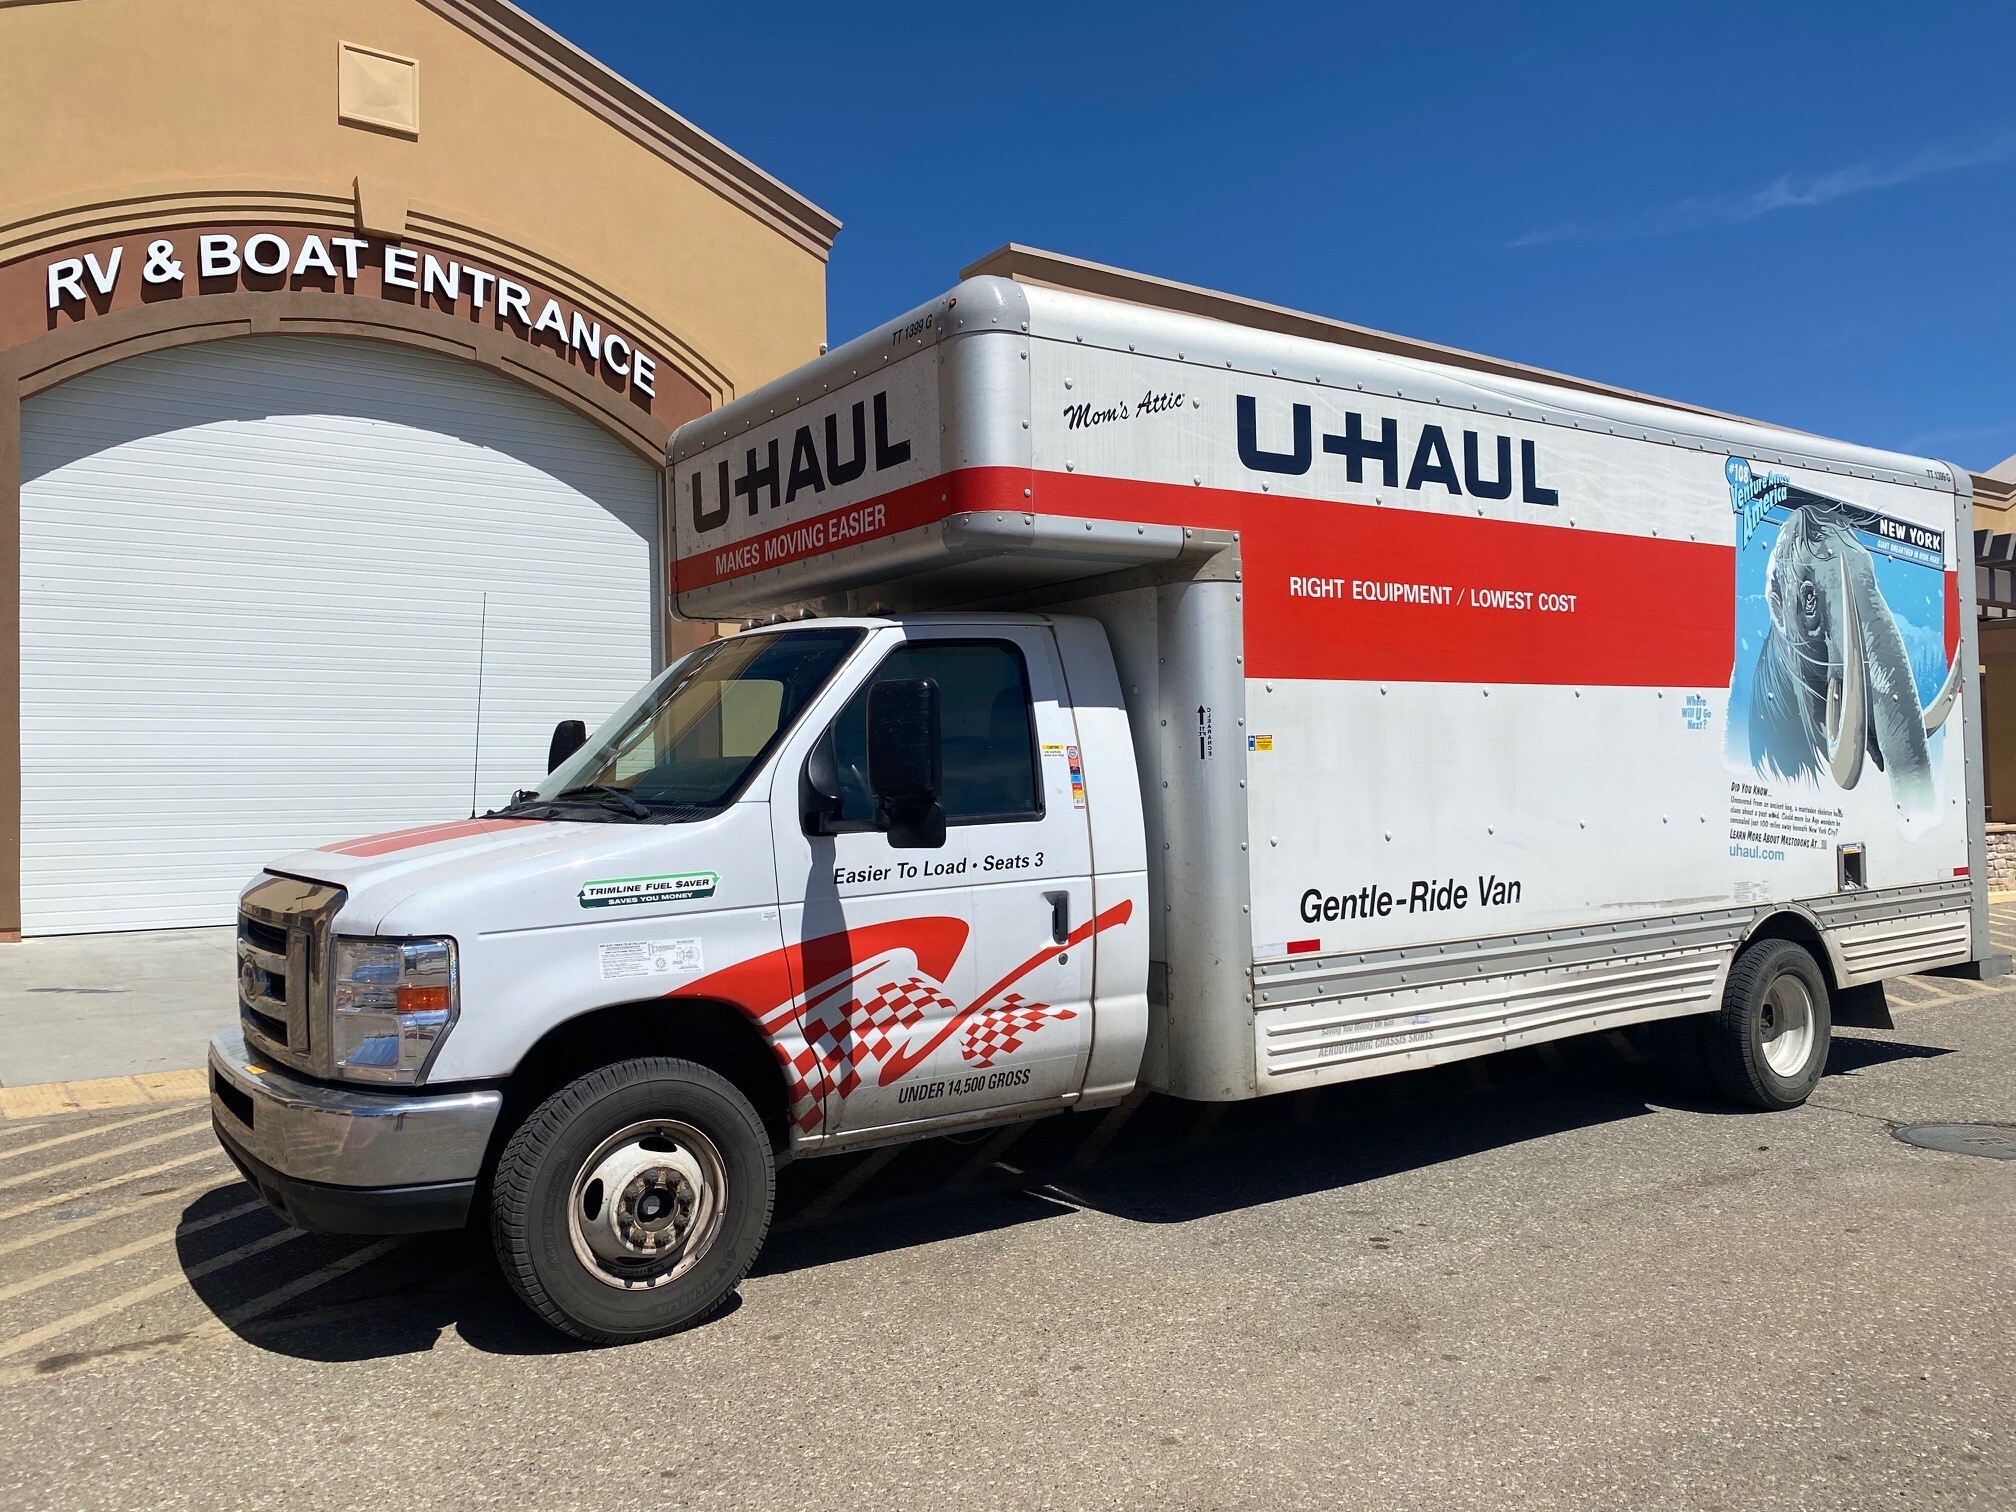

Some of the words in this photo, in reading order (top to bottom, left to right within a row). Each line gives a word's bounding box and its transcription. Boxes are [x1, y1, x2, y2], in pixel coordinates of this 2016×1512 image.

[48, 245, 123, 308] RV
[142, 239, 185, 284] &
[199, 233, 368, 279] BOAT
[384, 246, 656, 398] ENTRANCE
[893, 329, 903, 346] TT
[905, 319, 923, 339] 1399
[926, 314, 932, 329] G
[1063, 401, 1130, 430] Mom's
[1728, 463, 1749, 484] #108
[1729, 477, 1768, 513] Venture
[1743, 485, 1787, 549] America
[715, 546, 760, 576] MAKES
[764, 521, 824, 562] MOVING
[828, 503, 886, 542] EASIER
[1880, 518, 1906, 540] NEW
[1910, 527, 1940, 550] YORK
[1290, 576, 1345, 598] RIGHT
[1352, 580, 1453, 606] EQUIPMENT
[1456, 588, 1465, 606] /
[1470, 588, 1533, 610] LOWEST
[1538, 593, 1577, 613] COST
[1686, 695, 1706, 706] Where
[1682, 708, 1694, 718] Will
[1696, 708, 1702, 721] U
[1703, 709, 1711, 718] Go
[1687, 719, 1707, 729] Next?
[1731, 781, 1740, 792] DID
[1741, 783, 1752, 794] YOU
[1731, 796, 1752, 806] Uncovered
[1753, 798, 1763, 807] from
[1742, 807, 1753, 815] about
[1782, 812, 1793, 821] Could
[1730, 829, 1746, 840] LEARN
[1747, 831, 1762, 842] MORE
[1762, 832, 1780, 844] ABOUT
[1780, 835, 1810, 848] MASTODONS
[1730, 843, 1784, 861] uhaul.com
[833, 865, 891, 885] Easier
[897, 861, 918, 879] To
[924, 857, 967, 876] Load
[983, 854, 1030, 871] Seats
[1035, 852, 1044, 867] 3
[589, 884, 641, 895] TRIMLINE
[645, 881, 672, 891] FUEL
[608, 897, 638, 905] SAVES
[661, 892, 693, 900] MONEY
[1300, 878, 1468, 923] Gentle-Ride
[1478, 875, 1522, 907] Van
[1321, 1025, 1341, 1037] Saving
[1353, 1022, 1373, 1031] Money
[1318, 1042, 1373, 1058] AERODYNAMIC
[1375, 1037, 1407, 1048] CHASSIS
[1409, 1031, 1434, 1042] SKIRTS
[898, 1081, 945, 1103] UNDER
[948, 1075, 985, 1096] 14,500
[988, 1069, 1031, 1090] GROSS
